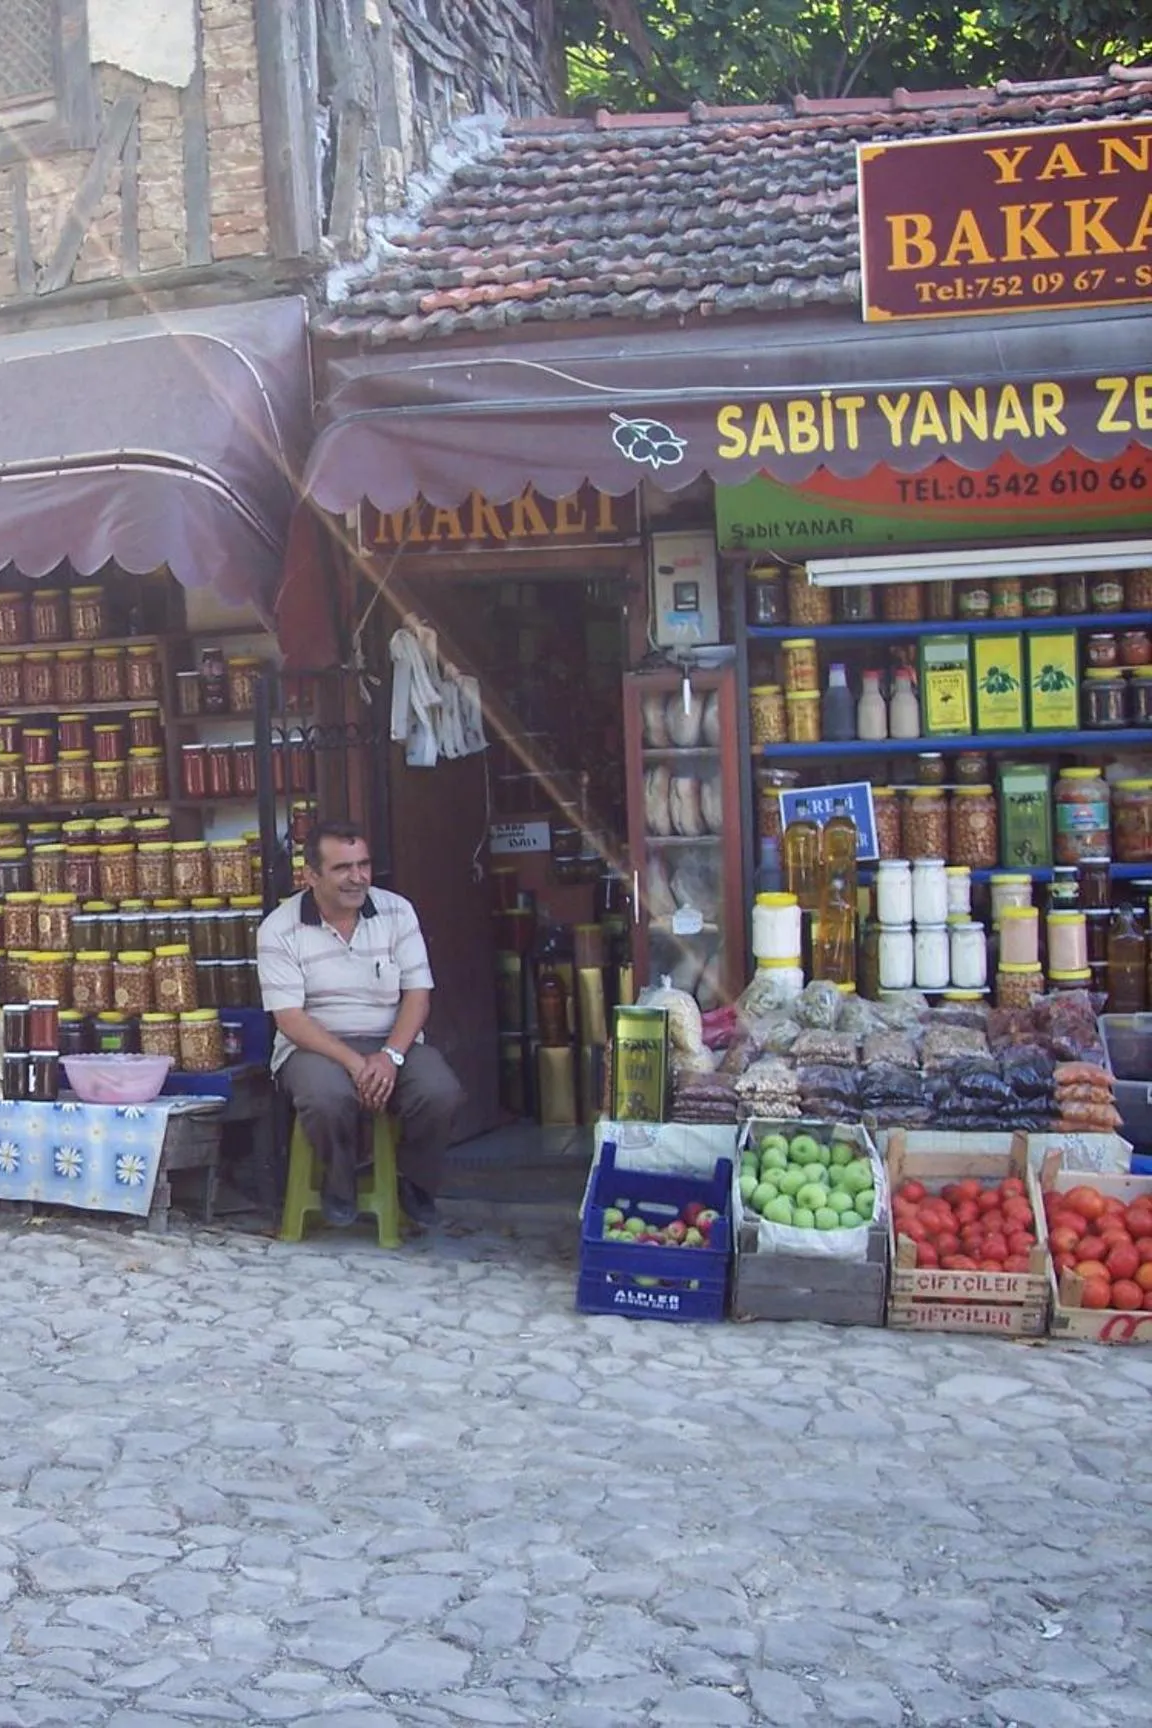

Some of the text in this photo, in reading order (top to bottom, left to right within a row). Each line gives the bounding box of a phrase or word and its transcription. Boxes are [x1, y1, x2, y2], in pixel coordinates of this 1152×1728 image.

[984, 135, 1152, 184] YAN
[915, 276, 1023, 302] Tel:752
[1032, 272, 1064, 294] 09
[1074, 269, 1106, 290] 67
[717, 390, 865, 459] SABİT
[879, 382, 1067, 446] YANAR
[896, 466, 1146, 503] TEL:0.542 610 66
[785, 517, 854, 536] YANAR
